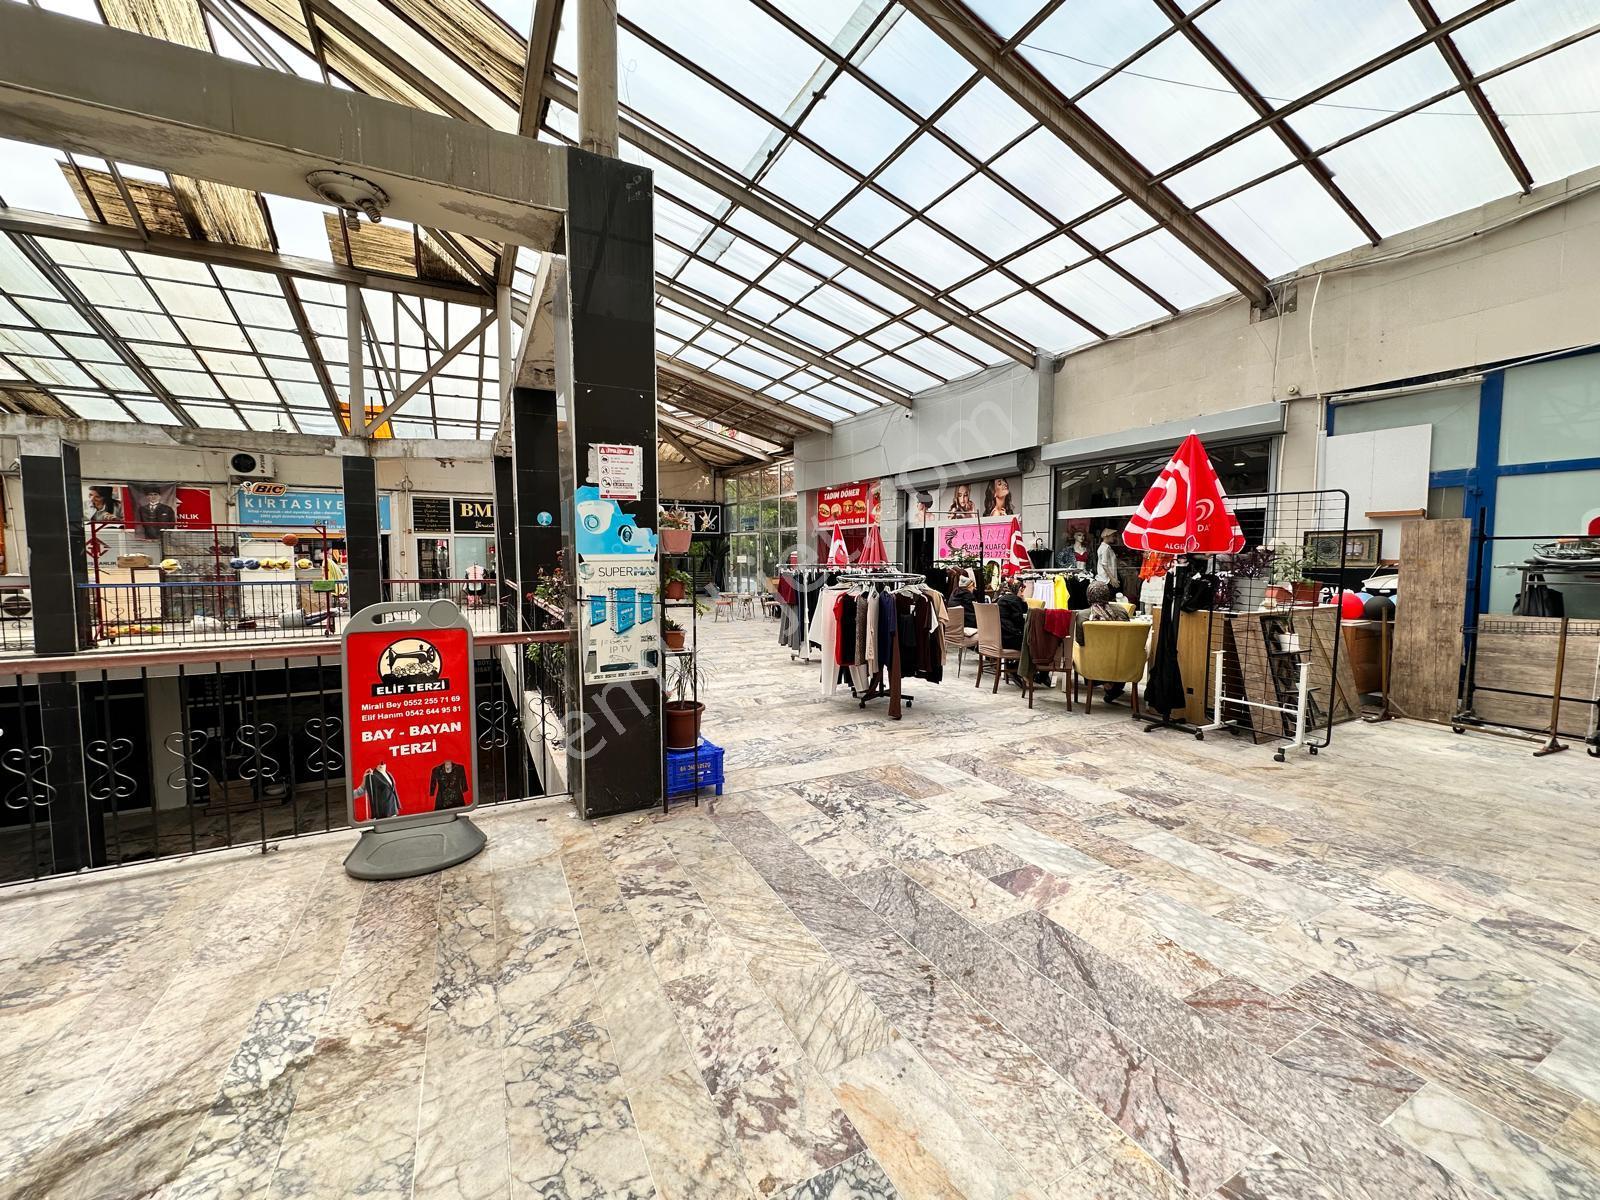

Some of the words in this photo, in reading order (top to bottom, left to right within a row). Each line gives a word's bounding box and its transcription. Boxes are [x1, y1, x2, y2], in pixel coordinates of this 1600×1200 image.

[376, 683, 405, 695] ELİF
[408, 680, 445, 692] TERZİ
[361, 703, 384, 711] Mirali
[386, 701, 401, 709] Bey
[403, 699, 422, 707] 0552
[361, 713, 376, 721] Elif
[405, 709, 424, 717] 0542
[361, 728, 395, 742] BAY
[409, 721, 462, 736] BAYAN
[389, 739, 437, 757] TERZİ
